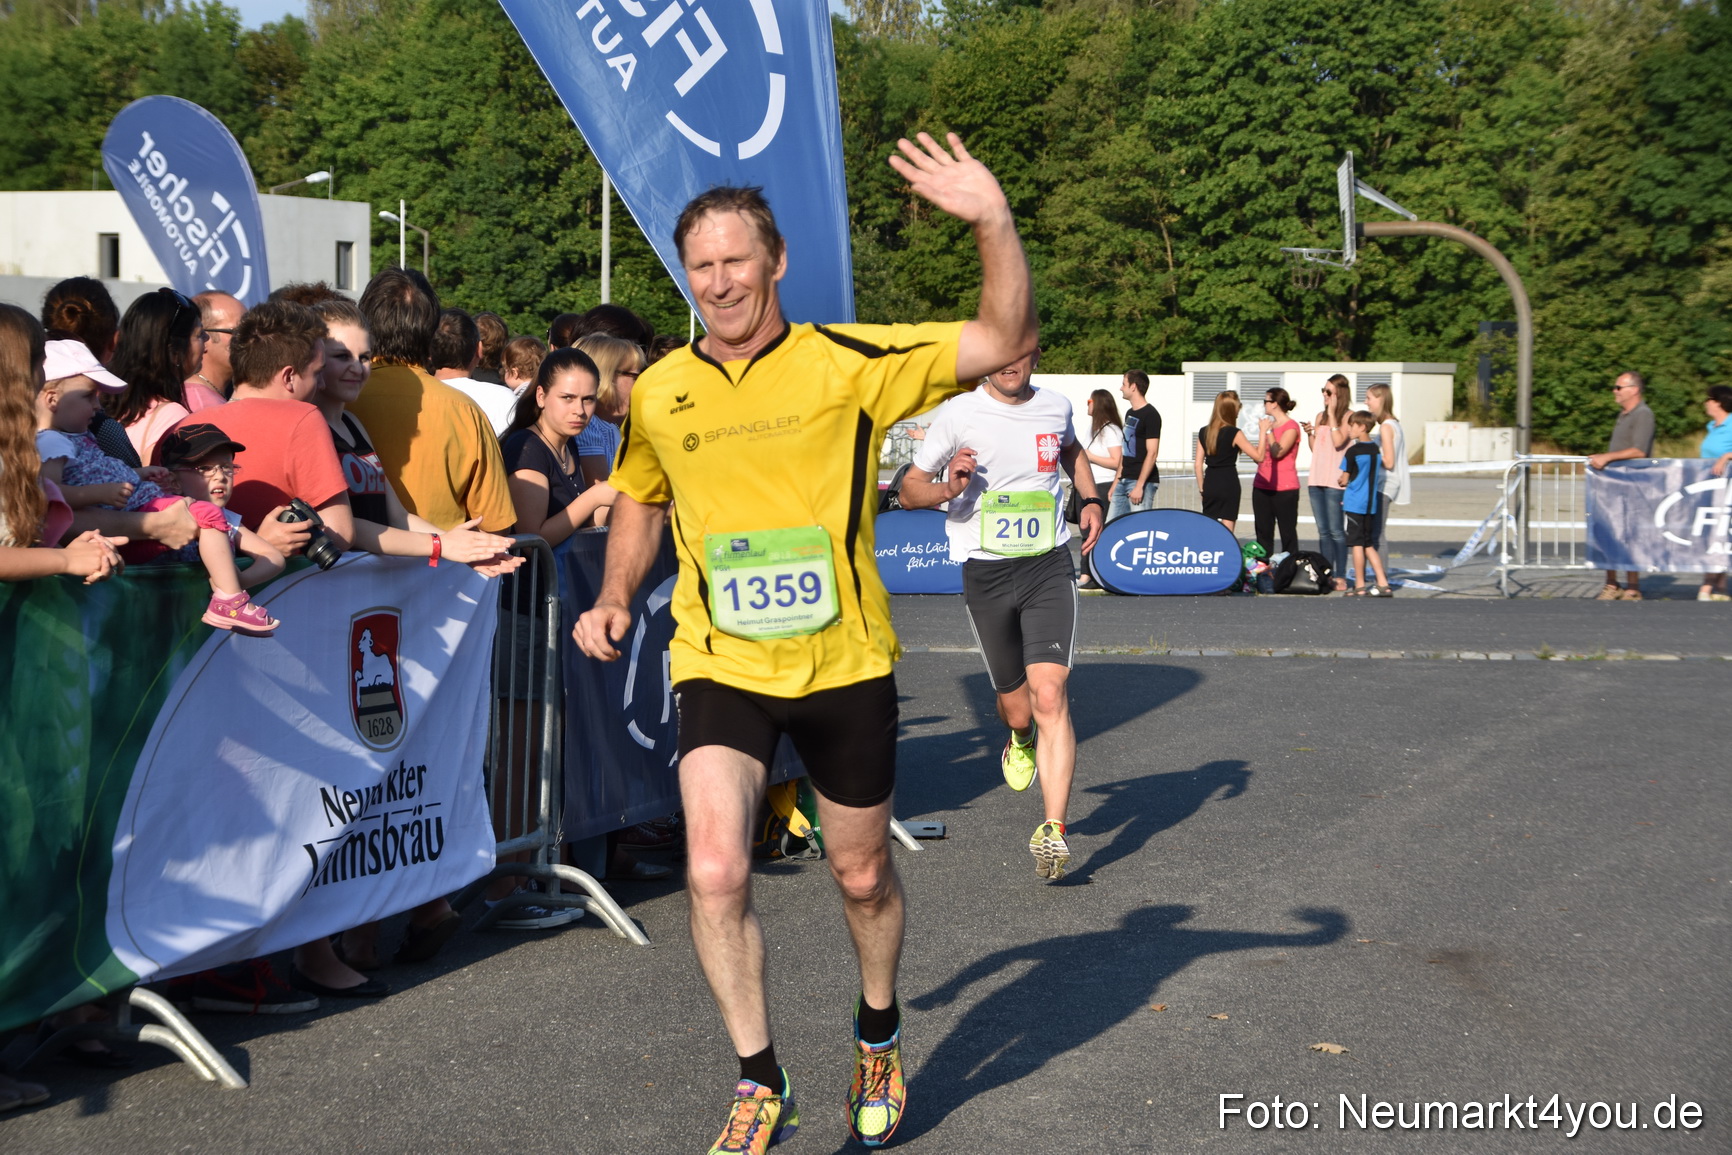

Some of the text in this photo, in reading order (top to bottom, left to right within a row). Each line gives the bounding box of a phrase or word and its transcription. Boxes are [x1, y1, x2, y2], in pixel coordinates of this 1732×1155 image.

[670, 402, 695, 415] erima
[704, 415, 800, 443] SPANGLER
[747, 428, 802, 442] AUTOMATION
[995, 517, 1040, 539] 210
[1691, 506, 1732, 537] Fi
[875, 544, 898, 557] und
[901, 542, 924, 554] das
[1132, 547, 1224, 565] Fischer
[906, 556, 939, 572] fährt
[1142, 566, 1219, 575] AUTOMOBILE
[723, 571, 822, 611] 1359
[737, 617, 764, 626] Helmut
[367, 716, 394, 738] 1628
